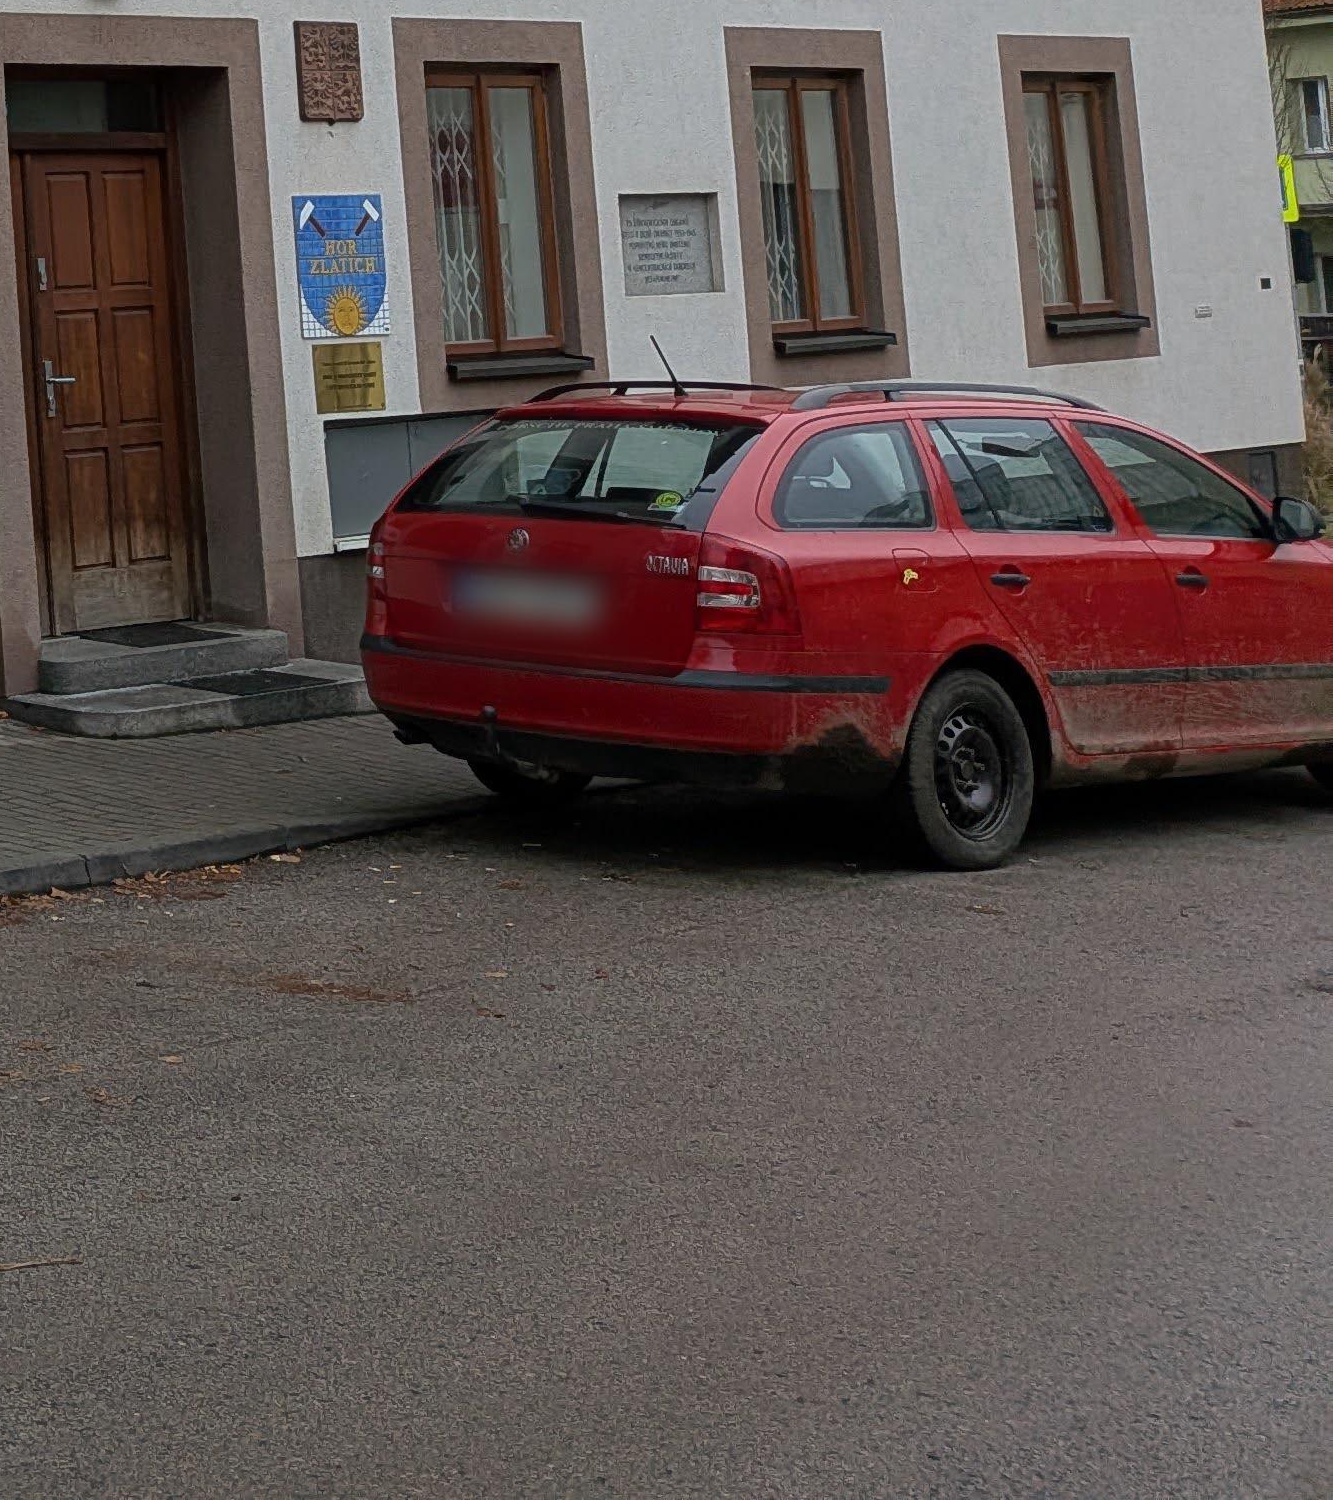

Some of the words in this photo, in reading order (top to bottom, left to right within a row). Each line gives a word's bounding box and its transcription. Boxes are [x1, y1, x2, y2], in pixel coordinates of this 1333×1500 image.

[325, 239, 358, 256] HOR
[309, 258, 376, 274] ZLATICH
[645, 554, 689, 576] OCTAVIA
